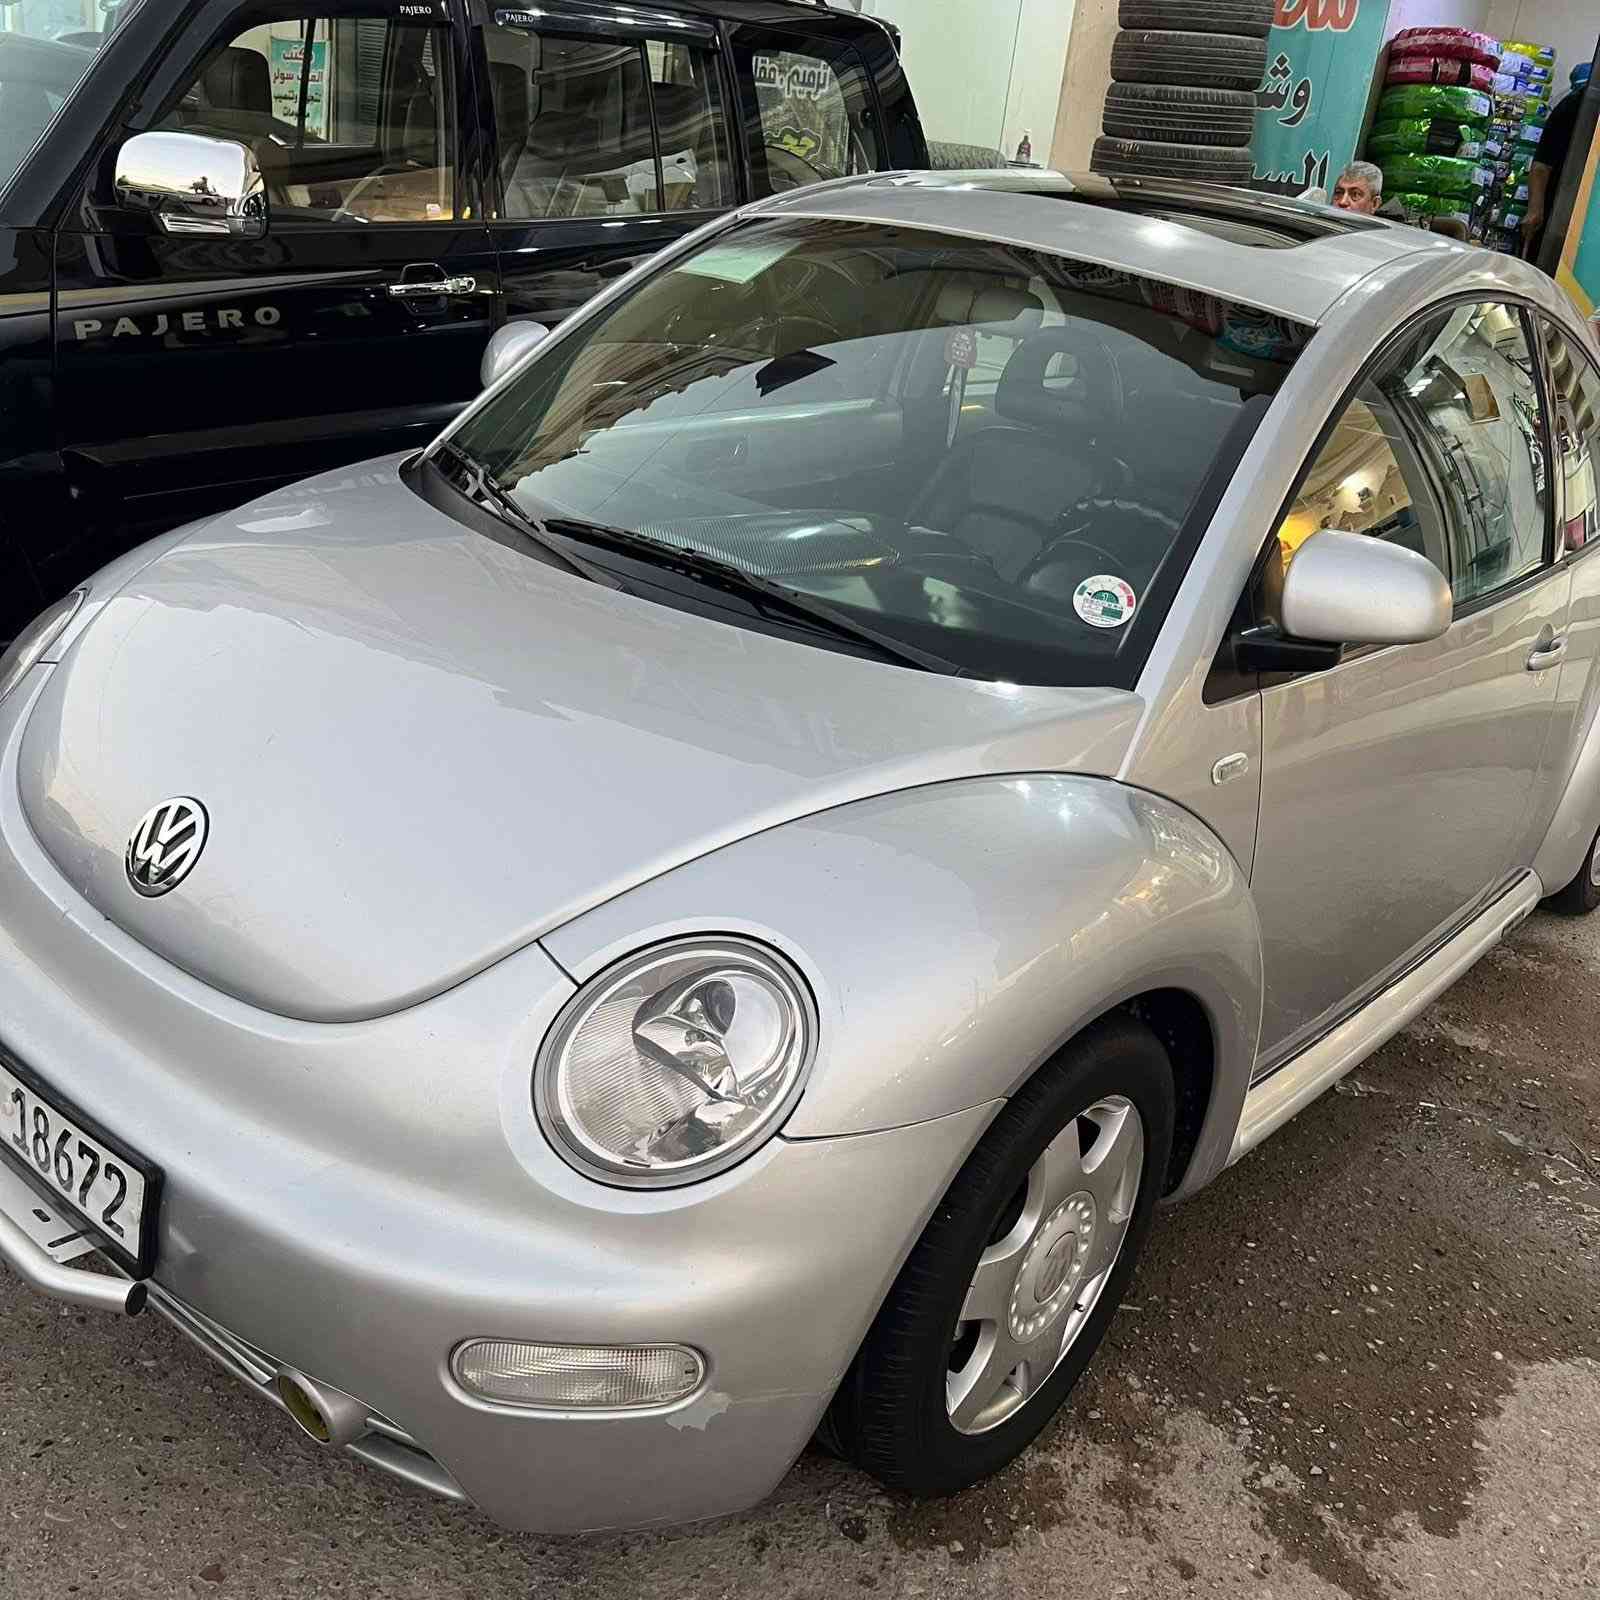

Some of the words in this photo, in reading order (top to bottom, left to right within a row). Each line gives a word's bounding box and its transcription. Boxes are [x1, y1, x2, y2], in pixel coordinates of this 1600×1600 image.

[400, 5, 432, 16] PAJERO
[505, 13, 534, 23] PAJERO
[282, 46, 313, 64] كتب
[1253, 52, 1312, 127] وش
[1251, 149, 1330, 197] الس
[73, 306, 281, 340] PAJERO
[11, 1087, 128, 1238] 18672
